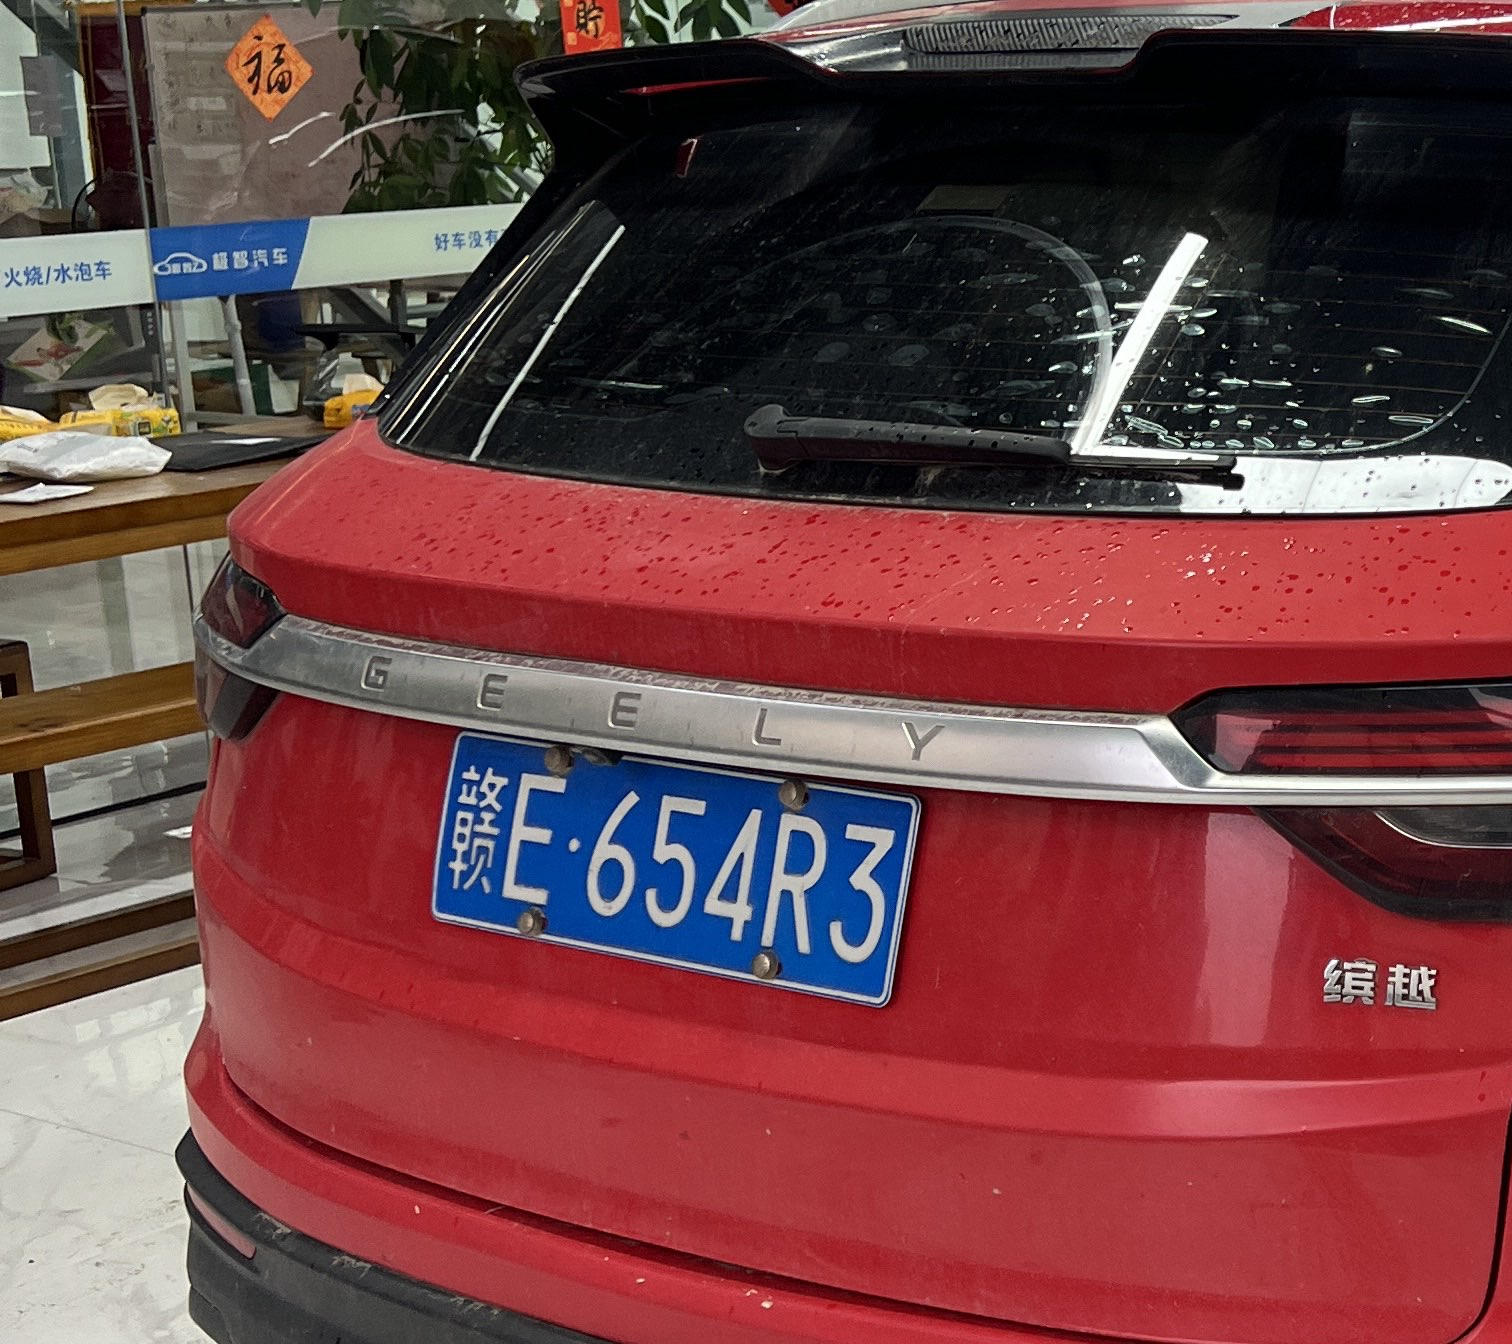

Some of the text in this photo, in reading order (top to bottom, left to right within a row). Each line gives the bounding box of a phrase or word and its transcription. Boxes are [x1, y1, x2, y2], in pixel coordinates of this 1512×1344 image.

[242, 35, 292, 96] 福
[434, 228, 506, 252] 好车没有
[4, 260, 112, 288] 火烧/水泡车
[358, 656, 945, 761] GEELY
[1323, 959, 1437, 1010] 缤越
